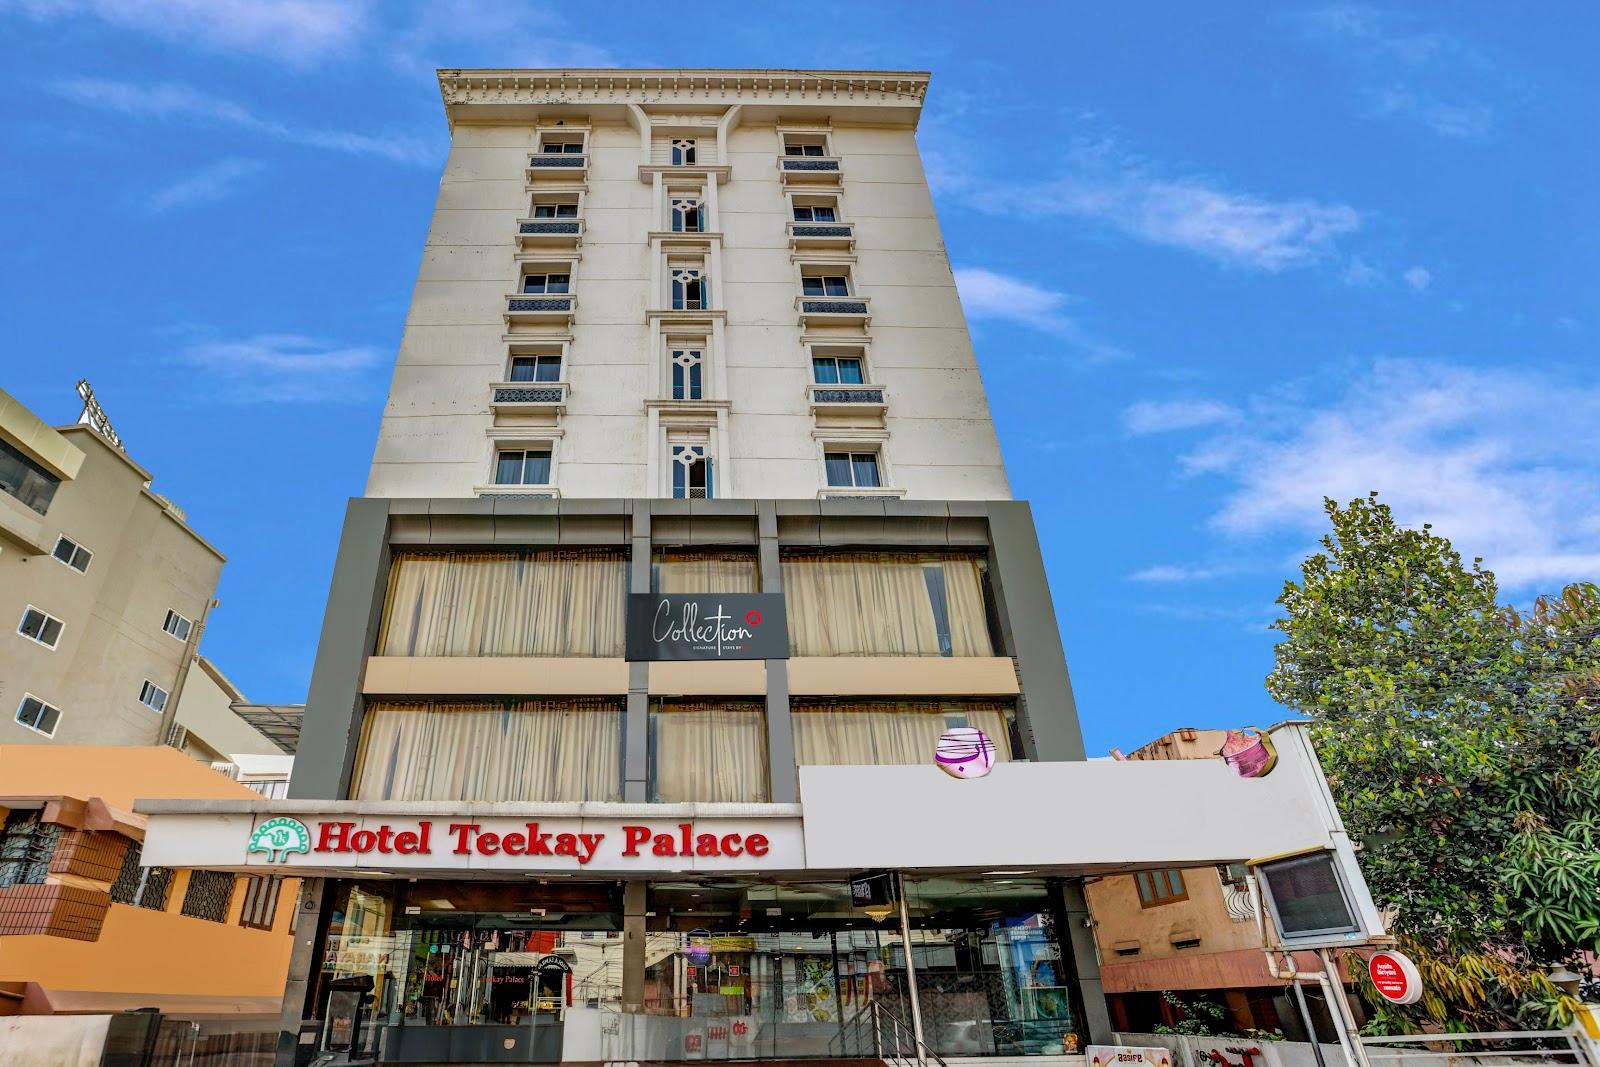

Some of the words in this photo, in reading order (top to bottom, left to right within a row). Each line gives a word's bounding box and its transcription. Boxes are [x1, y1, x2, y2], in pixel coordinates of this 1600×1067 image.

[653, 599, 752, 656] Collection
[313, 821, 433, 855] Hotel
[449, 822, 605, 865] Teekay
[621, 823, 769, 858] Palace
[505, 975, 525, 983] Palace
